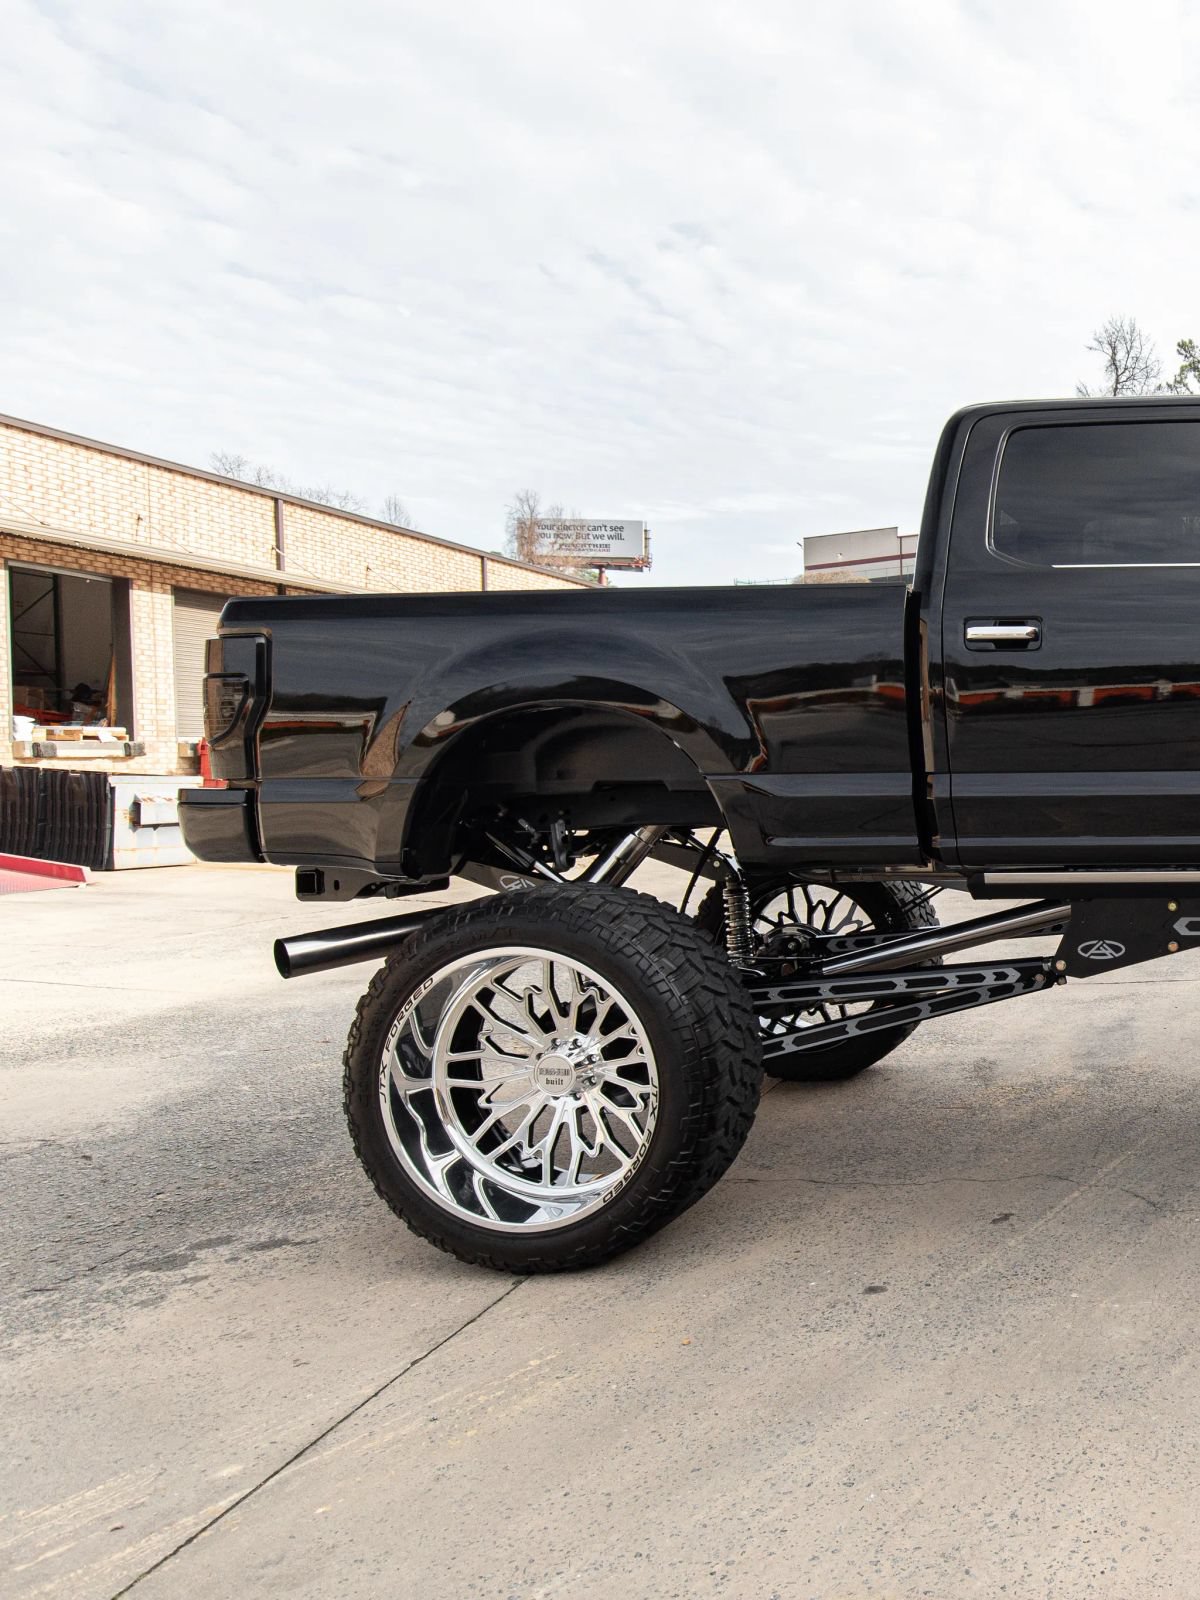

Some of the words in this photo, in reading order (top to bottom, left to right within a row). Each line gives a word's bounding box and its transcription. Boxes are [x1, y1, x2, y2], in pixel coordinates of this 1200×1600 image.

[587, 524, 607, 532] can't
[606, 533, 625, 541] will.
[379, 1060, 388, 1104] JTX
[385, 977, 434, 1052] FORGED
[545, 1077, 564, 1086] built
[649, 1076, 658, 1121] JTX
[602, 1128, 652, 1203] FORGED
